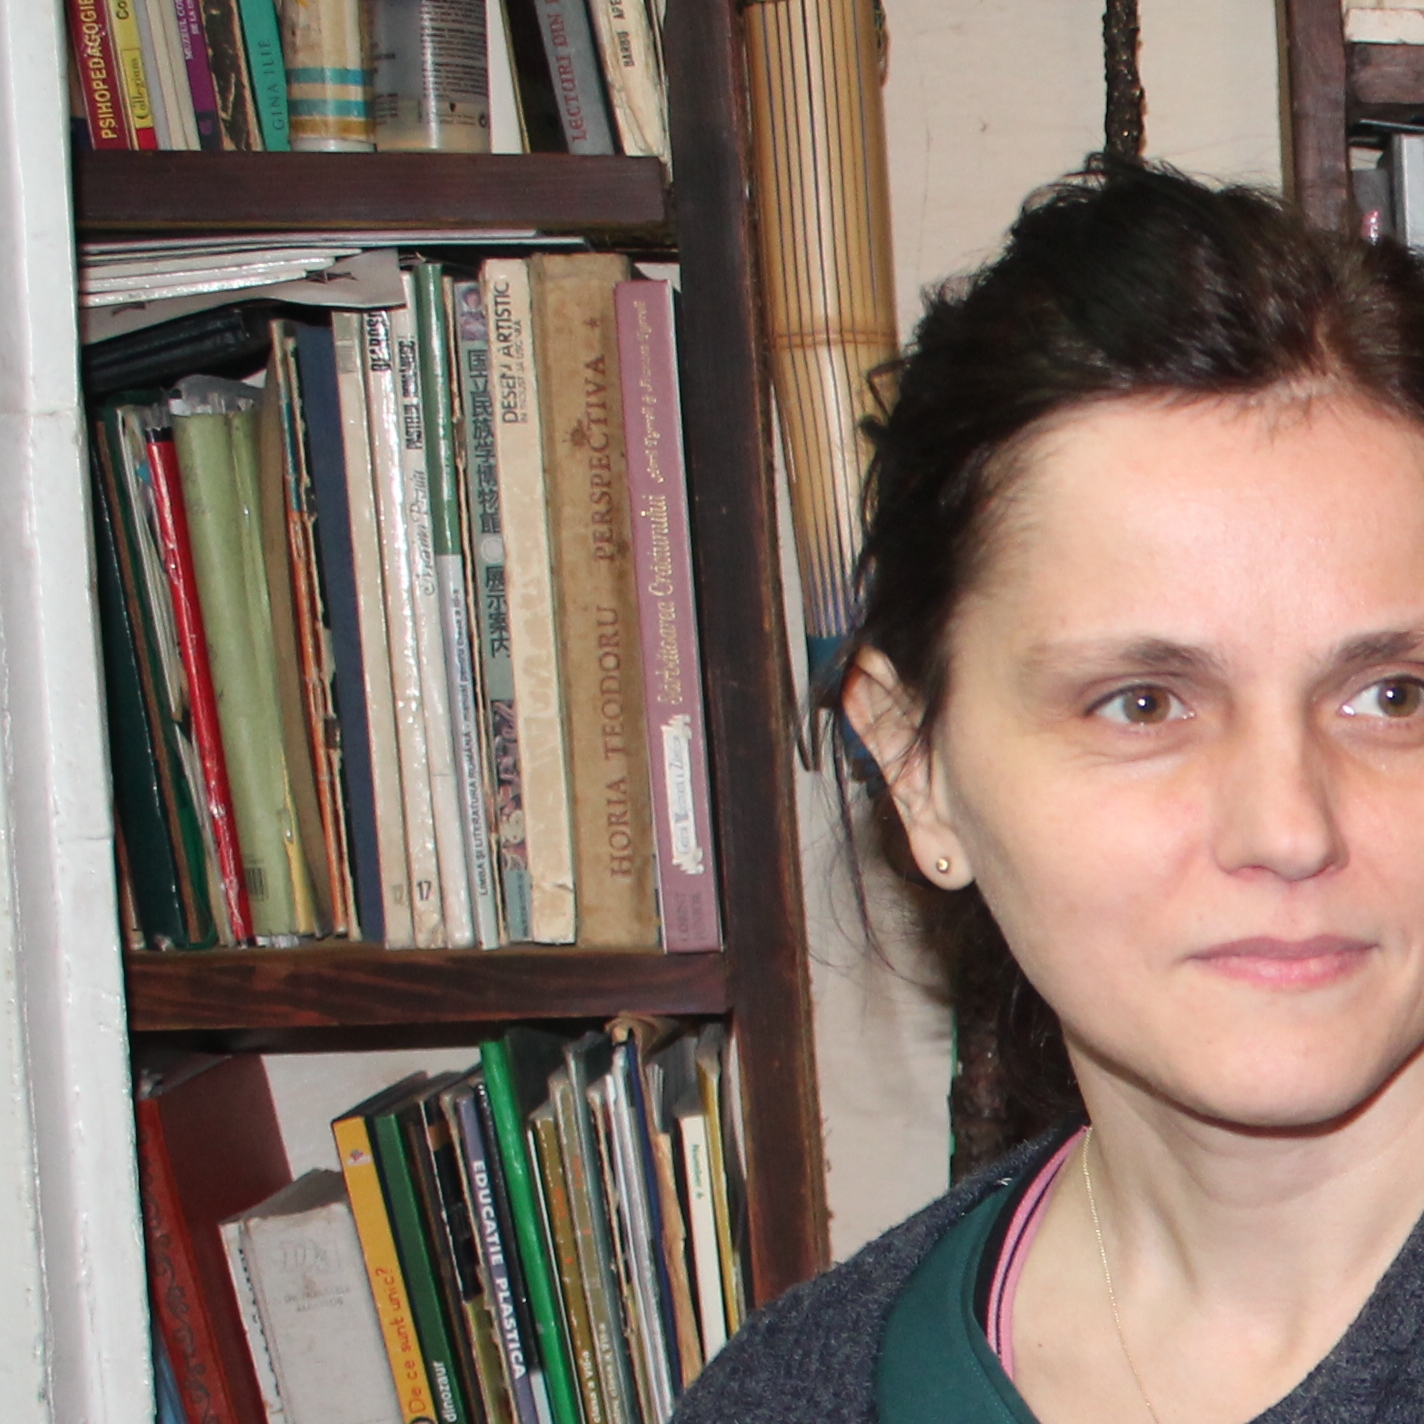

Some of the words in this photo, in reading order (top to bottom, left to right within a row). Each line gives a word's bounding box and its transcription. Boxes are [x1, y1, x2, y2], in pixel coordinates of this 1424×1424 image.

[176, 18, 194, 61] MUZEUL
[546, 11, 569, 47] DIN
[615, 32, 636, 67] BARBU
[257, 38, 276, 76] ILIE
[267, 84, 286, 131] GINA
[558, 54, 588, 143] LECTURI
[492, 282, 513, 359] ARTISTIC
[584, 354, 615, 563] PERSPECTIVA
[641, 495, 675, 597] Crăciunului
[653, 602, 684, 705] Sărbătoarea
[595, 604, 629, 760] TEODORU
[467, 780, 484, 848] LITERATURA
[604, 774, 633, 878] HORIA
[416, 880, 432, 901] 17
[475, 861, 490, 896] LIMBA
[374, 1265, 402, 1311] unic?
[470, 1159, 504, 1267] EDUCATIE
[493, 1276, 527, 1380] PLASTICA
[387, 1316, 412, 1353] sunt
[403, 1358, 419, 1381] ce
[432, 1358, 457, 1422] dinozaur
[407, 1386, 427, 1414] De
[590, 1391, 602, 1424] clasa
